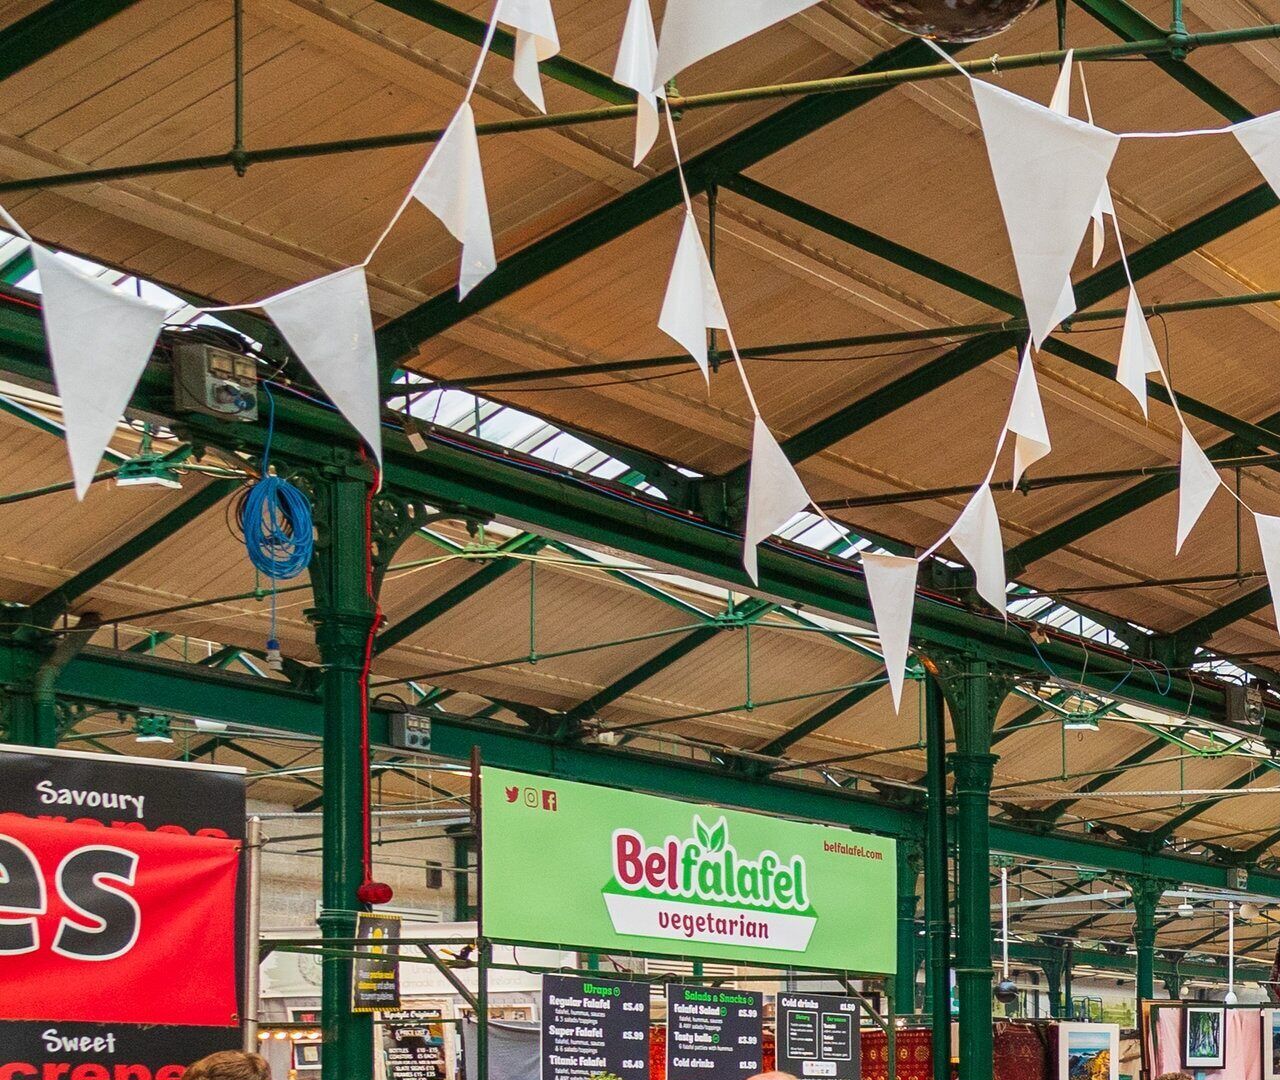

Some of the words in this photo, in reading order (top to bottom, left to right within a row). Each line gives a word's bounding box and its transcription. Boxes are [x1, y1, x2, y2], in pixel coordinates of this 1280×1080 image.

[36, 780, 145, 818] Savoury
[823, 840, 883, 860] belfalafel.com
[614, 830, 807, 905] Belfalafel
[658, 911, 769, 939] vegetarian
[583, 983, 612, 997] Wraps
[684, 991, 711, 1002] Salads
[549, 995, 582, 1008] Regular
[583, 998, 611, 1009] Falafel
[782, 997, 797, 1008] Cold
[798, 999, 819, 1009] drinks
[674, 1003, 698, 1014] Falafel
[699, 1004, 720, 1015] Salad
[549, 1025, 574, 1038] Super
[575, 1026, 603, 1038] Falafel
[673, 1031, 693, 1044] Tasty
[694, 1033, 712, 1043] balls
[42, 1029, 116, 1053] Sweet
[549, 1055, 577, 1066] Titanic
[579, 1057, 606, 1067] Falafel
[673, 1057, 690, 1067] Cold
[691, 1058, 715, 1069] drinks
